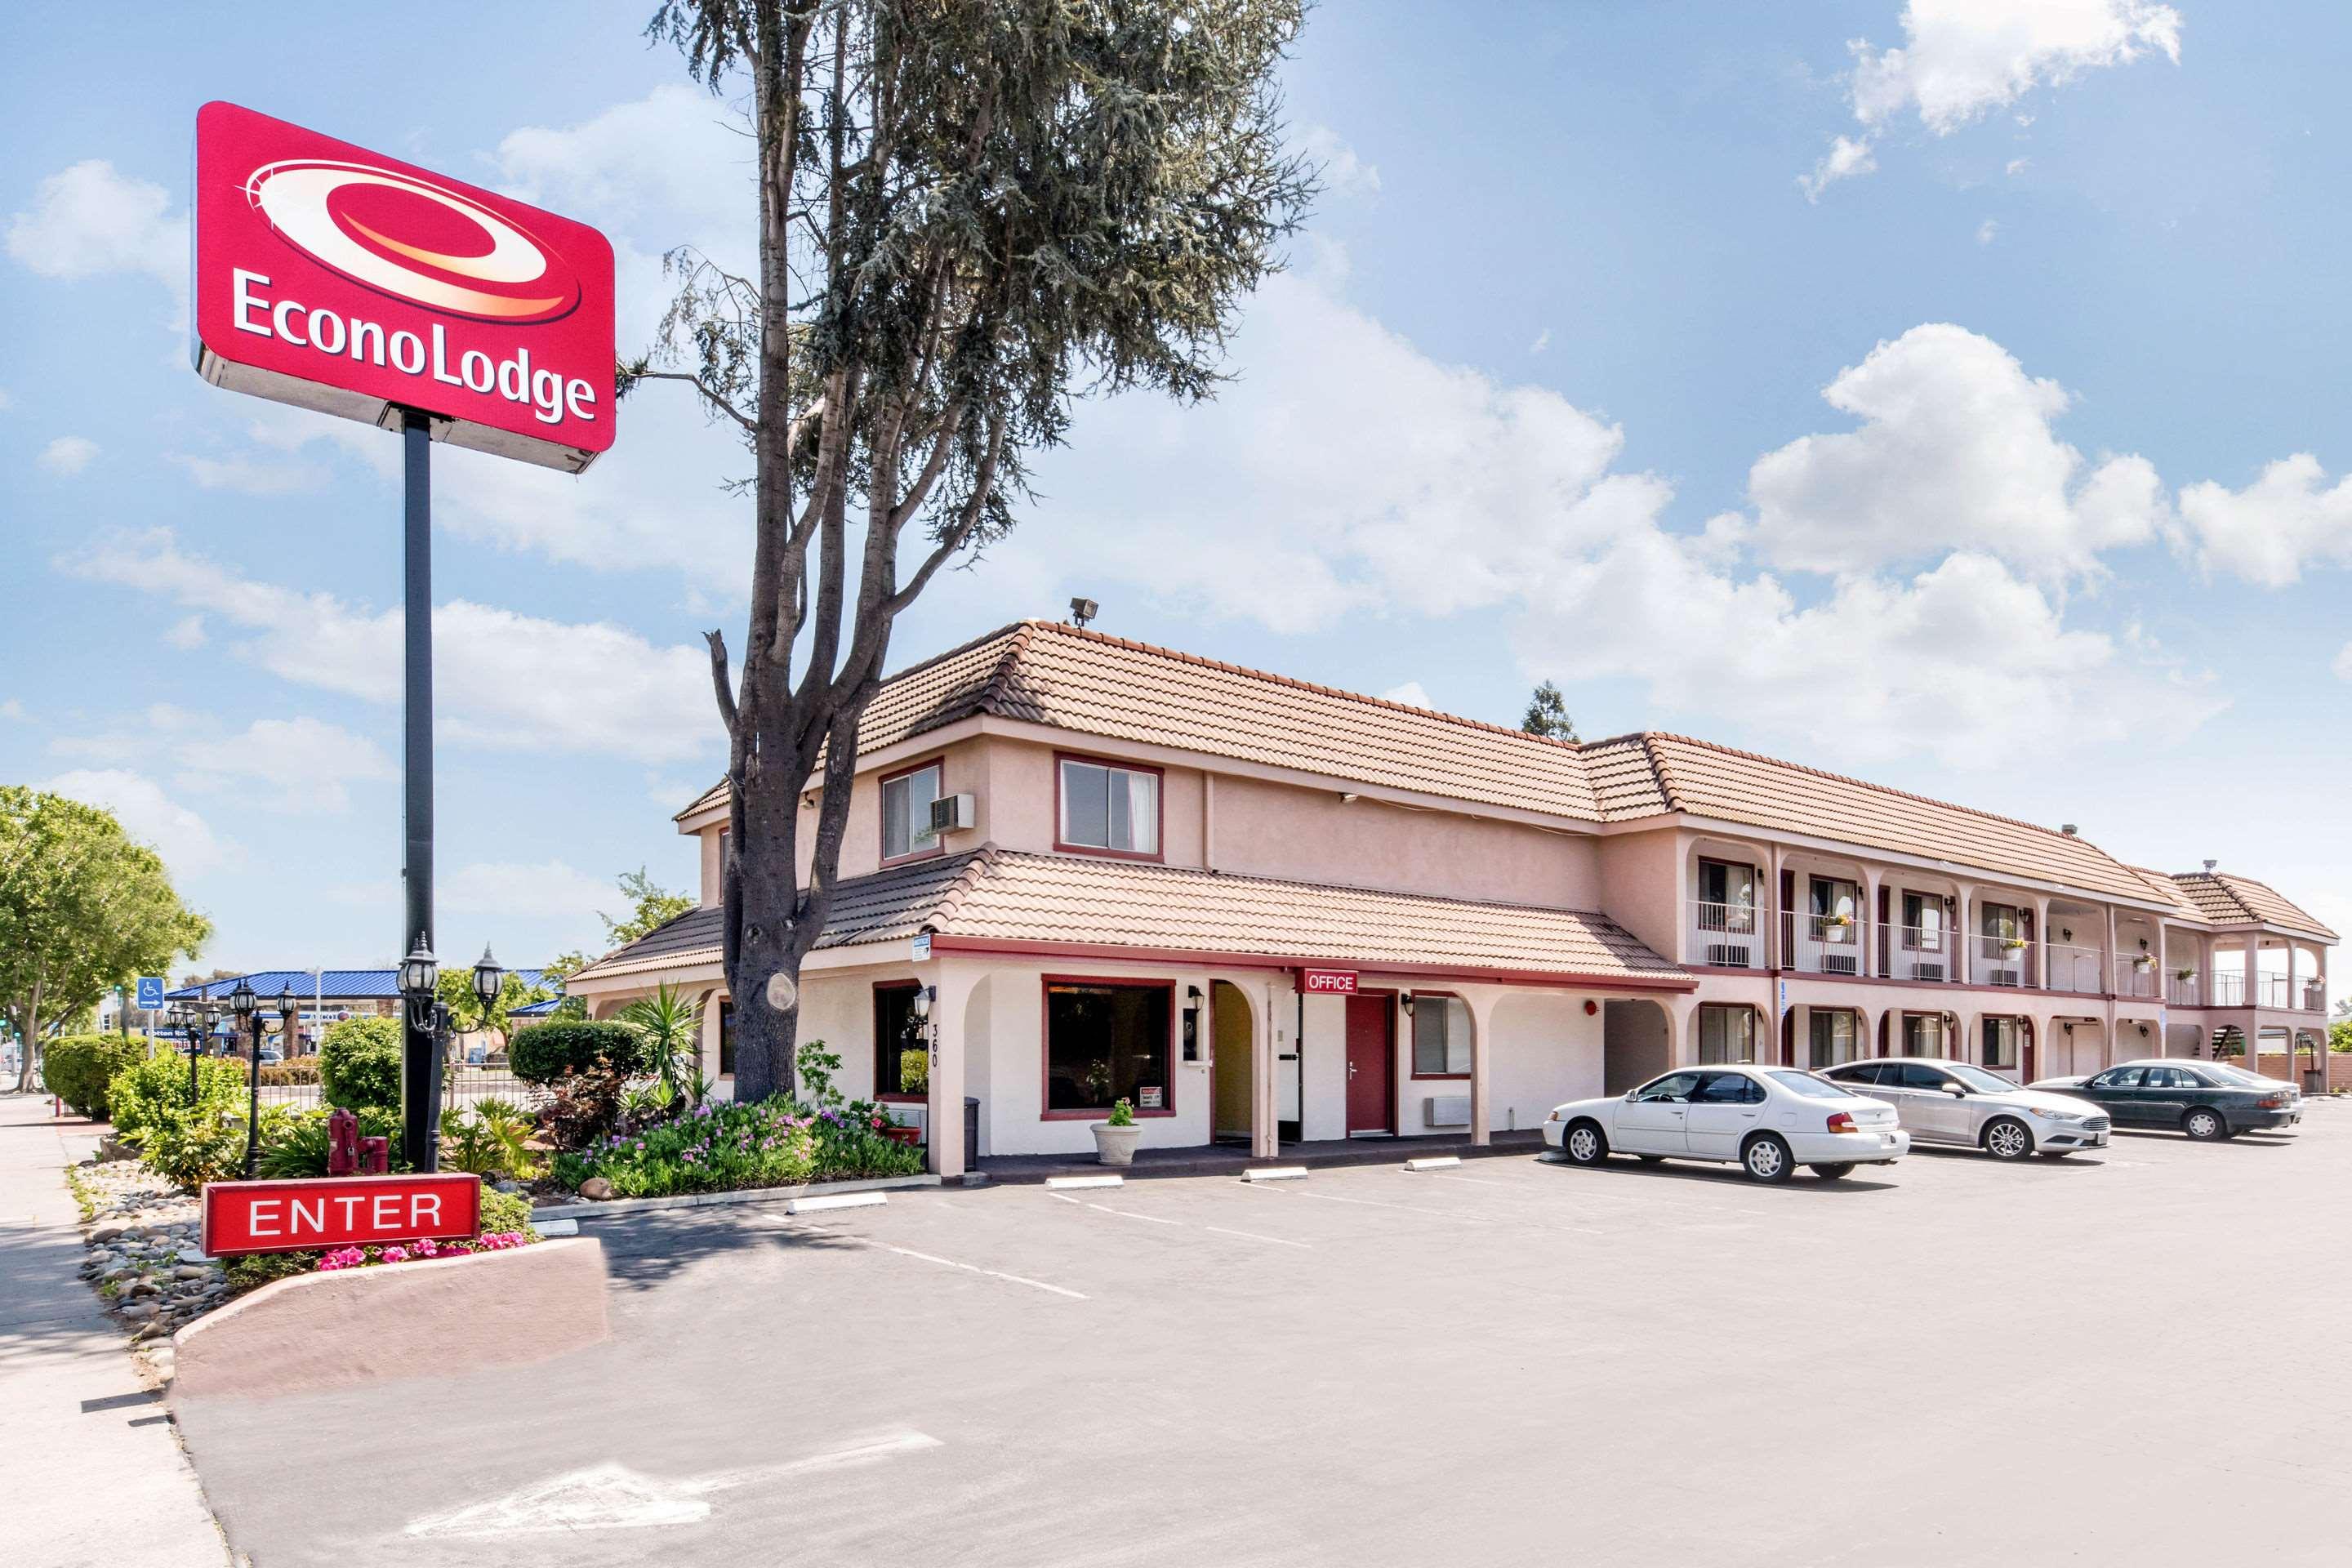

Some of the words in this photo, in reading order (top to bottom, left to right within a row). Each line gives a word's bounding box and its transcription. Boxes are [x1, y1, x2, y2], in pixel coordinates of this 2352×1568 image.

[233, 267, 595, 423] EconoLodge
[1309, 975, 1353, 990] OFFICE
[250, 1193, 441, 1236] ENTER
